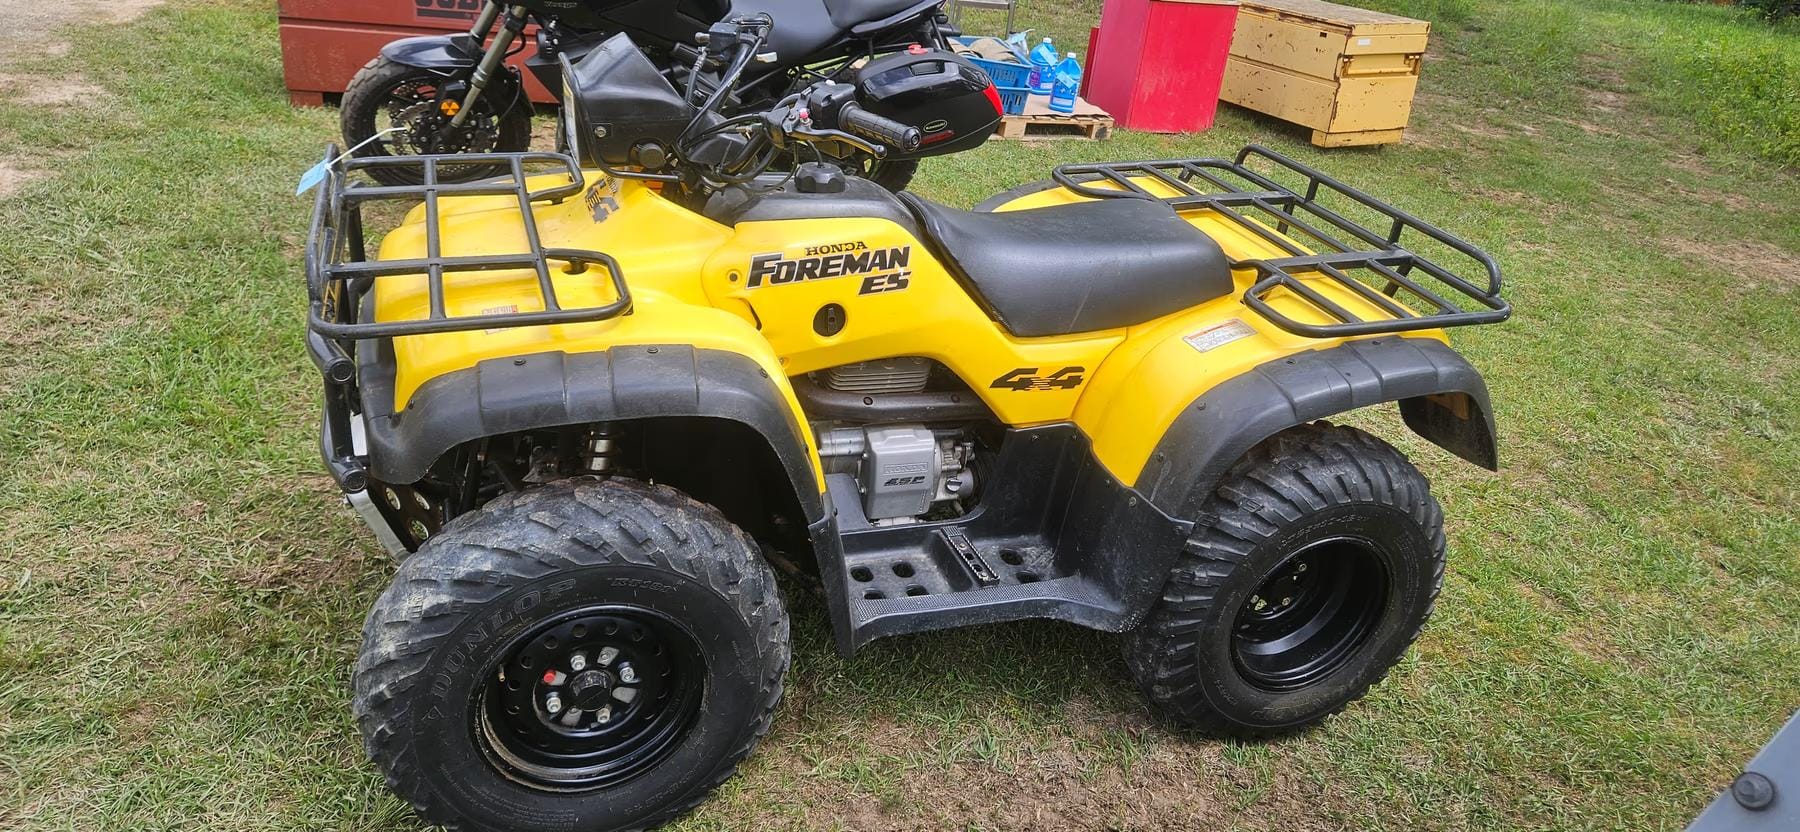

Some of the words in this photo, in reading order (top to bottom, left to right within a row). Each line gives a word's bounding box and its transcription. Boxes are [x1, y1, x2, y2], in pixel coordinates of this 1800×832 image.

[805, 241, 868, 256] HONDA
[747, 246, 911, 289] FOREMAN
[858, 271, 912, 296] ES
